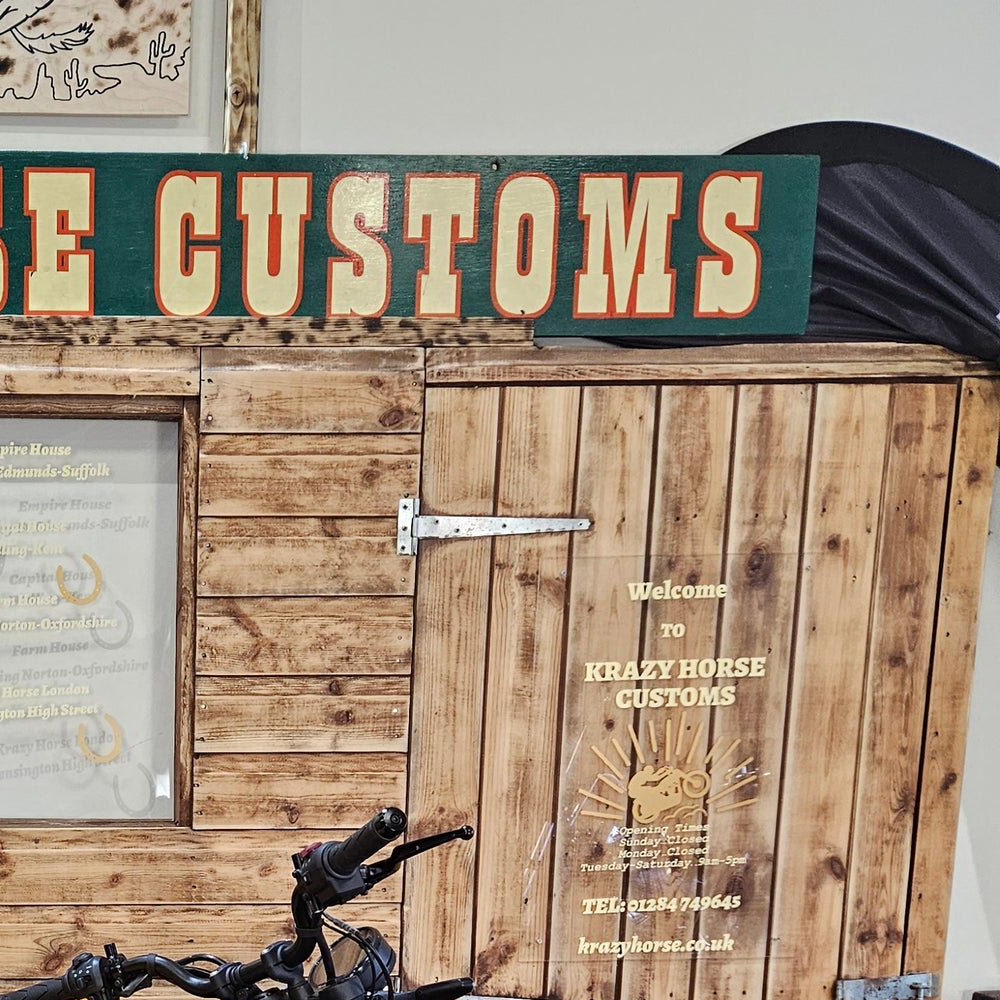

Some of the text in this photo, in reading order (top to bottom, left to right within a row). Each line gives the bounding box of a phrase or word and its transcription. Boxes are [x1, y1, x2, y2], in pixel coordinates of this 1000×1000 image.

[155, 169, 764, 319] CUSTOMS
[29, 443, 72, 456] House
[628, 580, 727, 600] Welcome
[18, 593, 58, 607] House
[661, 623, 686, 637] TO
[584, 657, 766, 682] KRAZY HORSE
[2, 685, 40, 698] Horse
[40, 683, 90, 697] London
[616, 686, 736, 709] CUSTOMS
[27, 705, 58, 721] High
[60, 704, 99, 717] Street
[619, 824, 710, 837] Opening Times
[582, 894, 741, 915] TEL: 01284 749645
[578, 934, 735, 958] krazyhorse.co.uk
